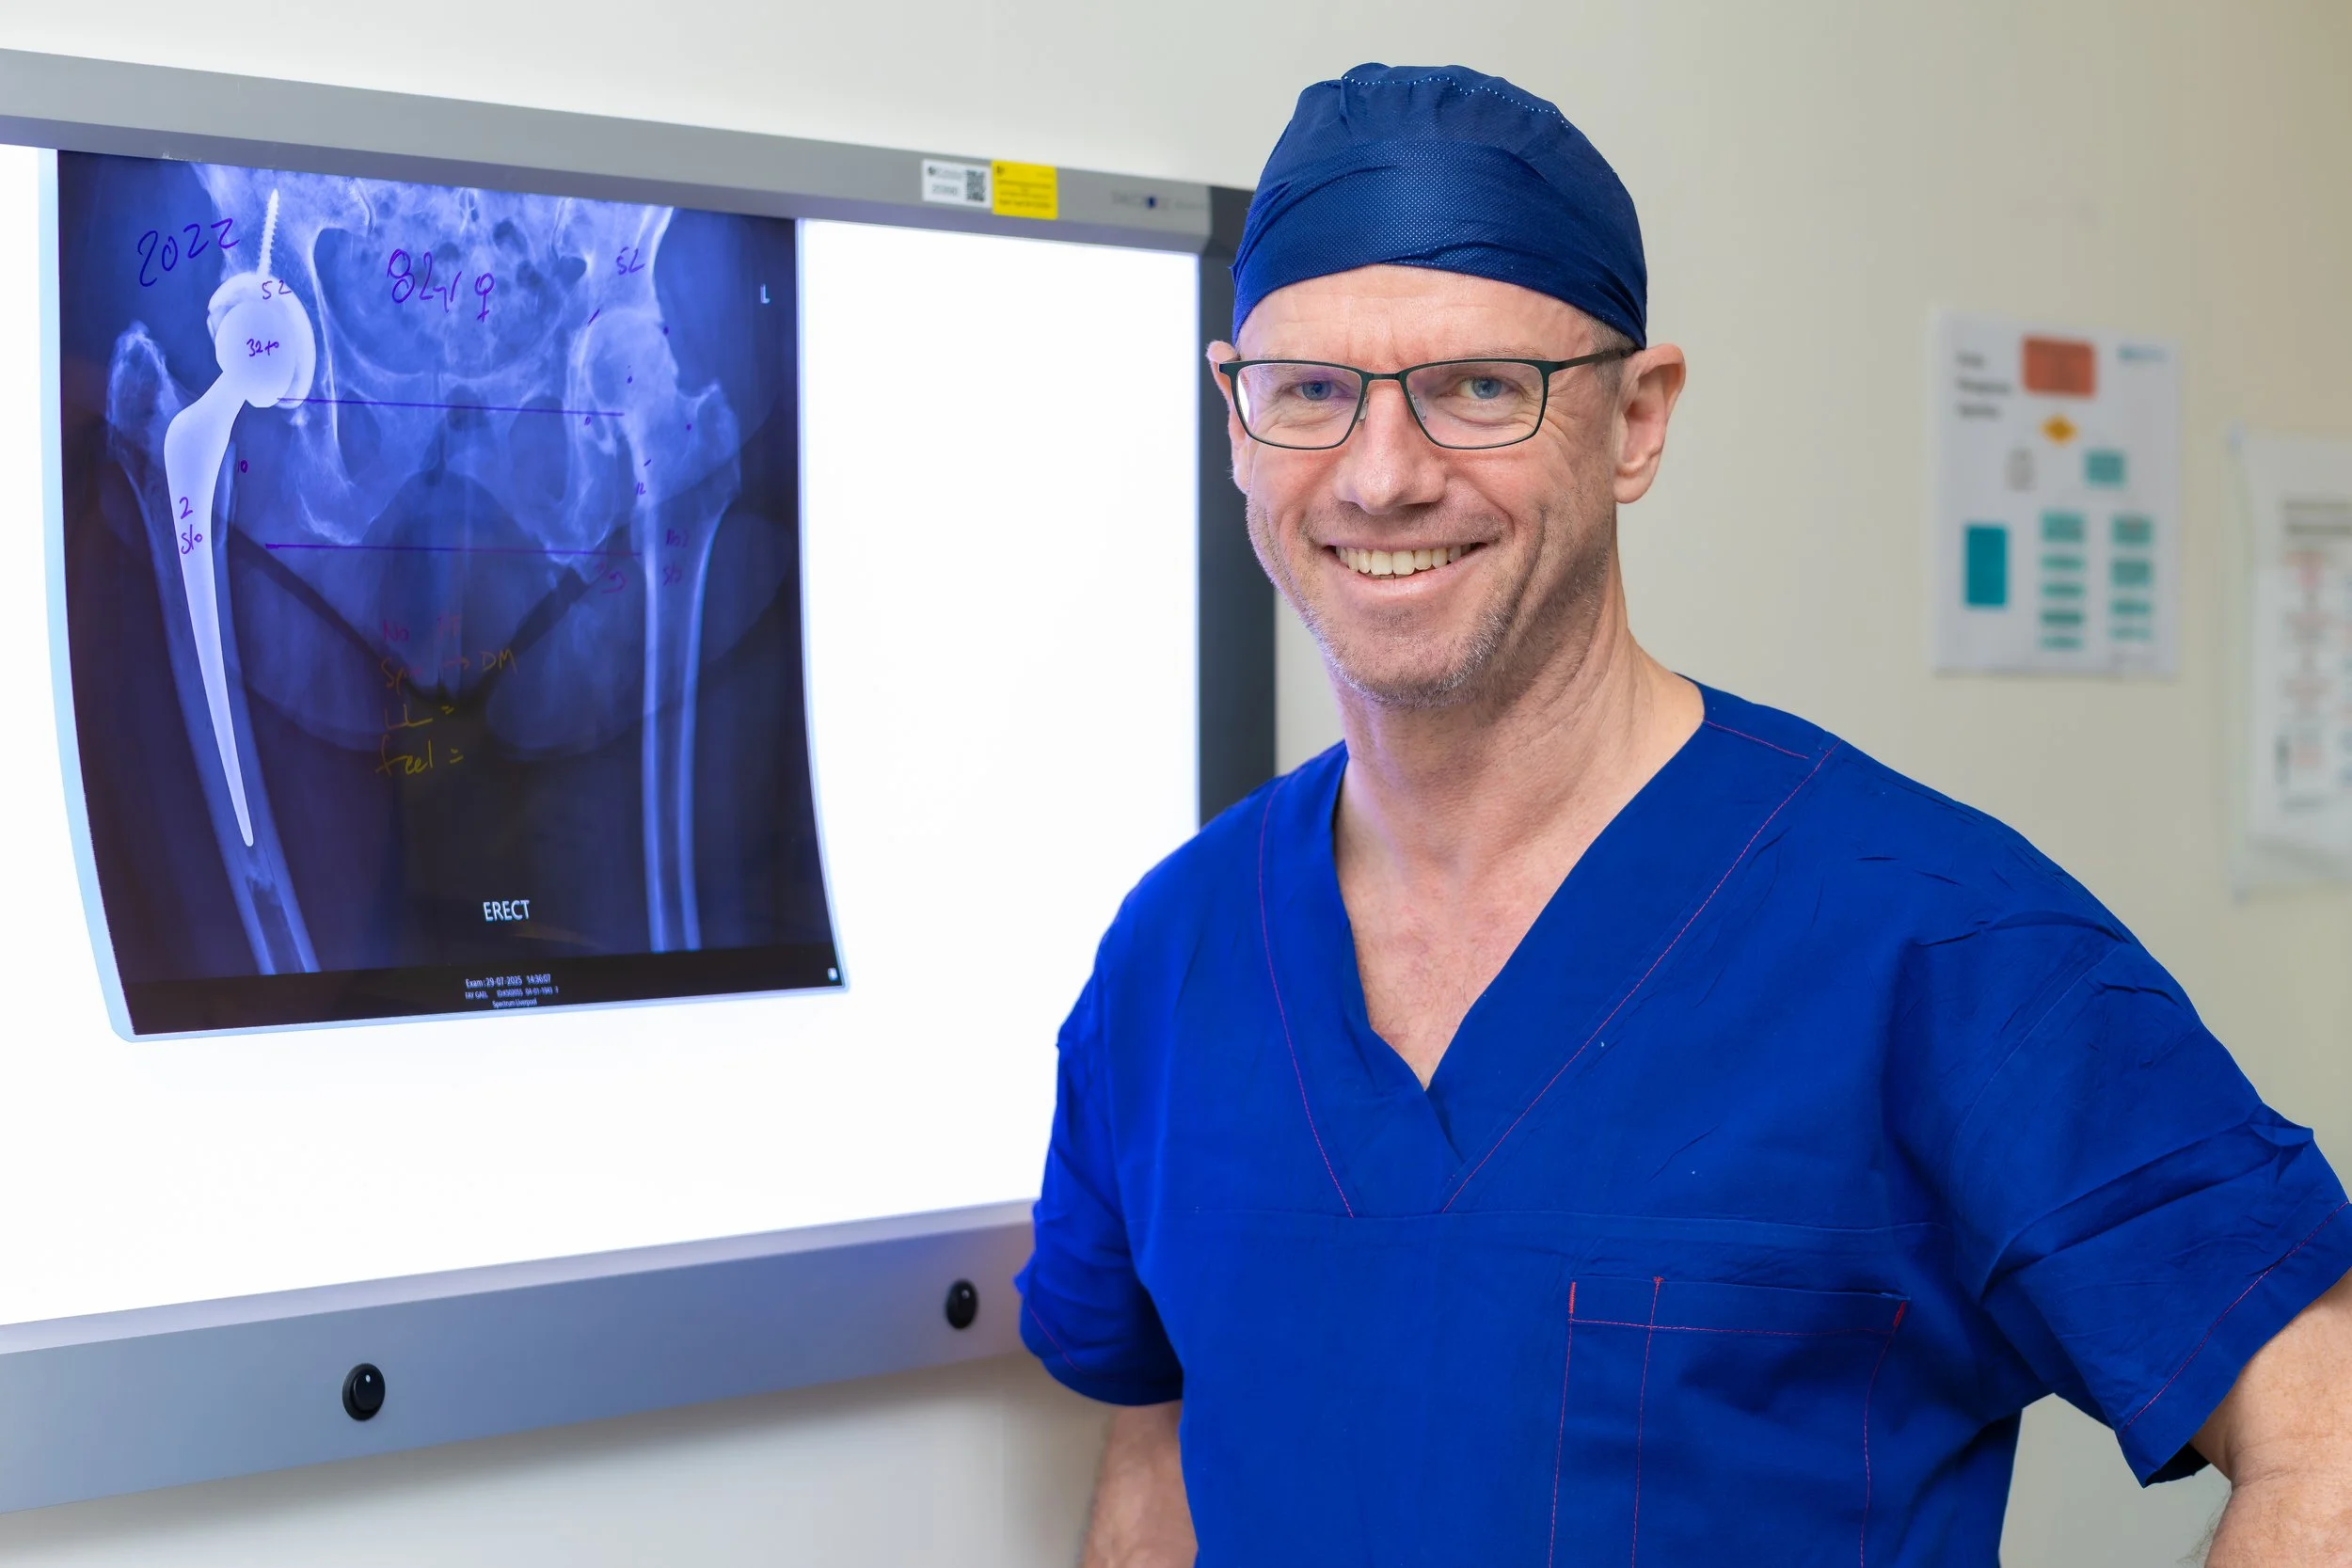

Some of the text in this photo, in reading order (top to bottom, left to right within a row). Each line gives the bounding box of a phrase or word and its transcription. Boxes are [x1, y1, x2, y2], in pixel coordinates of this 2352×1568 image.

[137, 217, 241, 287] 2022
[262, 278, 293, 300] 52
[760, 283, 771, 304] L
[179, 496, 194, 520] 2
[483, 899, 530, 923] ERECT
